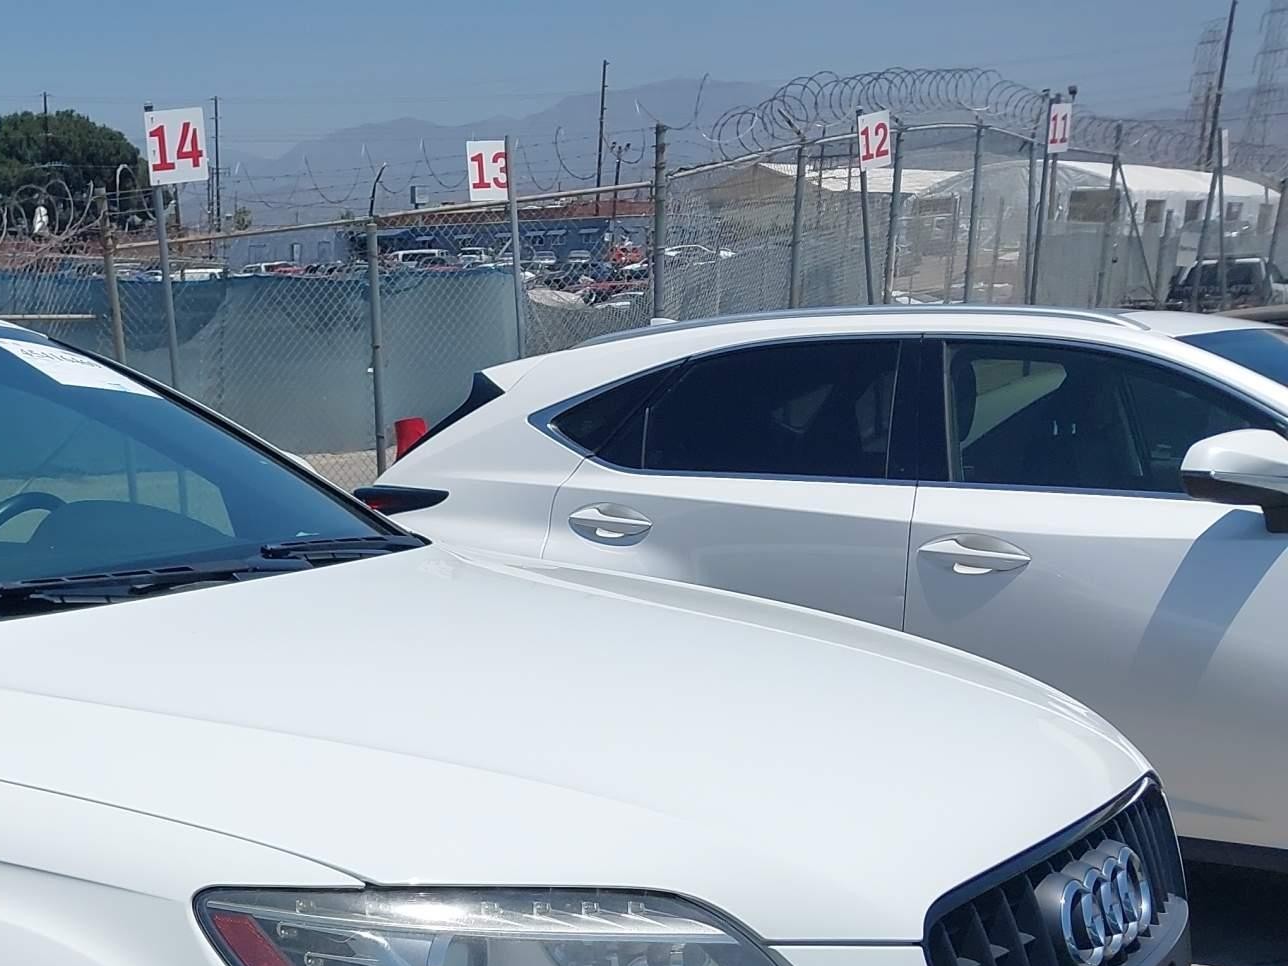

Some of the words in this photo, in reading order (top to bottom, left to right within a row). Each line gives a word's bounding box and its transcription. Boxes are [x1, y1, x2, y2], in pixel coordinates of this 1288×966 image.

[149, 122, 203, 172] 14
[861, 123, 889, 161] 12
[1050, 113, 1068, 144] 11
[471, 151, 509, 189] 13
